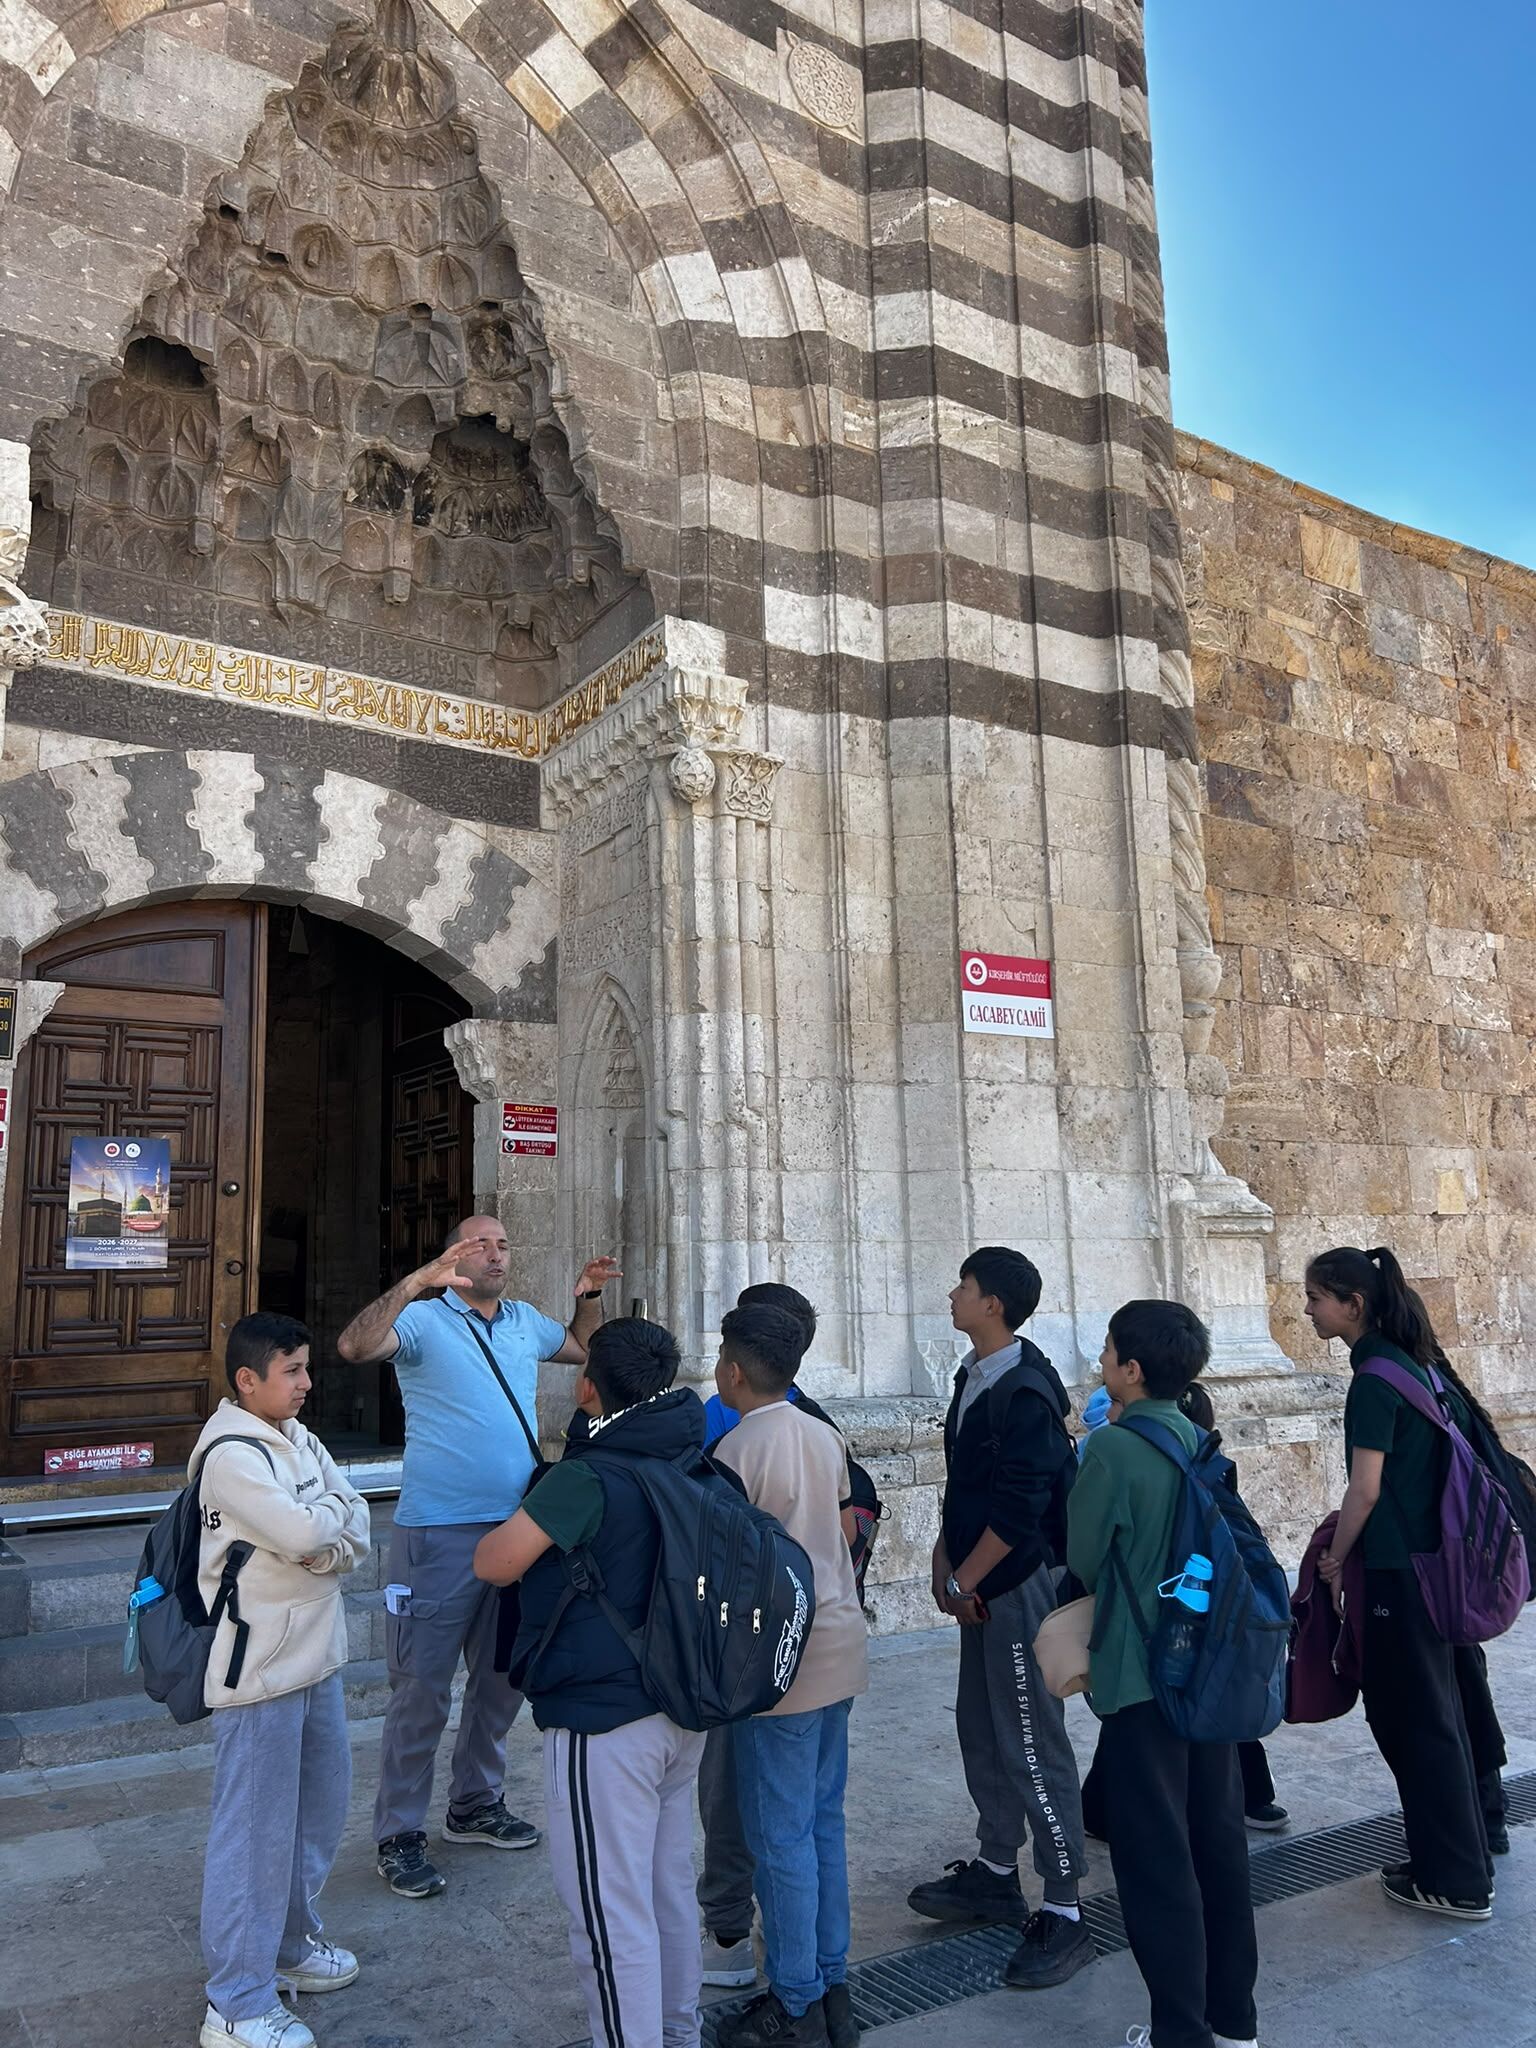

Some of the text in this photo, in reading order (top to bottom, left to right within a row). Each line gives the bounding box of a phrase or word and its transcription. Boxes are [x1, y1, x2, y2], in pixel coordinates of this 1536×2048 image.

[969, 1004, 1047, 1028] CACABEY CAMİİ
[514, 1105, 544, 1113] DİKKAT
[64, 1445, 136, 1461] EŞİĞE AYAKKABI İLE
[78, 1458, 122, 1469] BASMAYINIZ
[1011, 1642, 1071, 1877] YOU CAN DO WHAT YOU WANT AS ALWAYS
